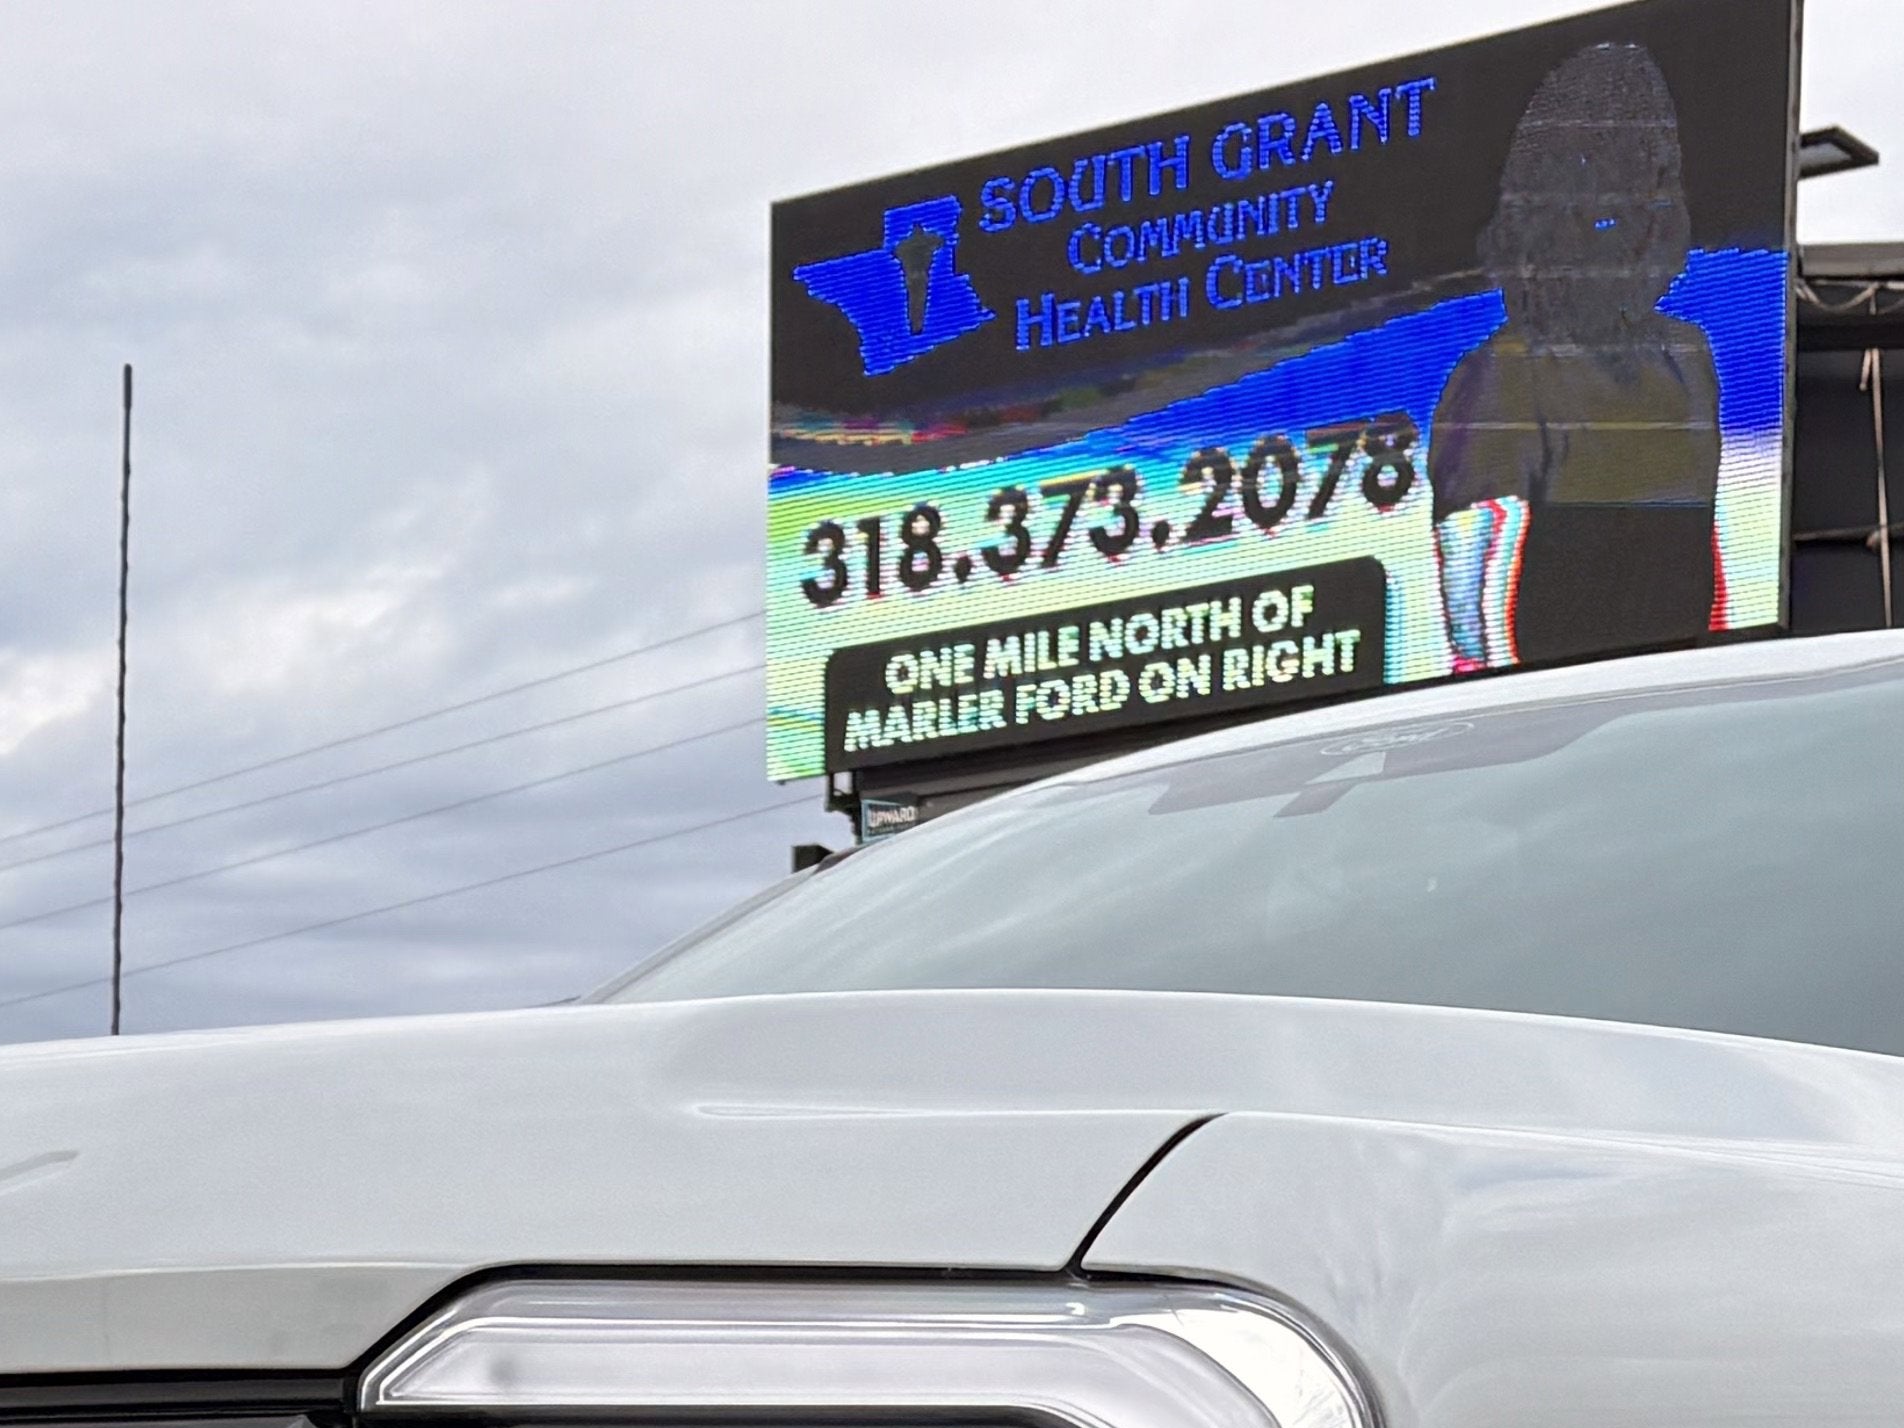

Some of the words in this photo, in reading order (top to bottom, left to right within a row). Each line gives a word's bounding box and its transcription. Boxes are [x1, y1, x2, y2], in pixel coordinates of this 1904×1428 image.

[979, 135, 1190, 233] SOUTH
[1211, 77, 1436, 181] GRANT
[799, 413, 1418, 608] 318.373.2078
[843, 689, 1006, 753] MARLER
[1014, 668, 1131, 725] FORD
[1138, 653, 1212, 704] ON
[1222, 630, 1362, 691] RIGHT
[884, 642, 975, 695] ONE
[983, 625, 1081, 681] MILE
[1088, 594, 1242, 662] NORTH
[1251, 585, 1316, 634] OF
